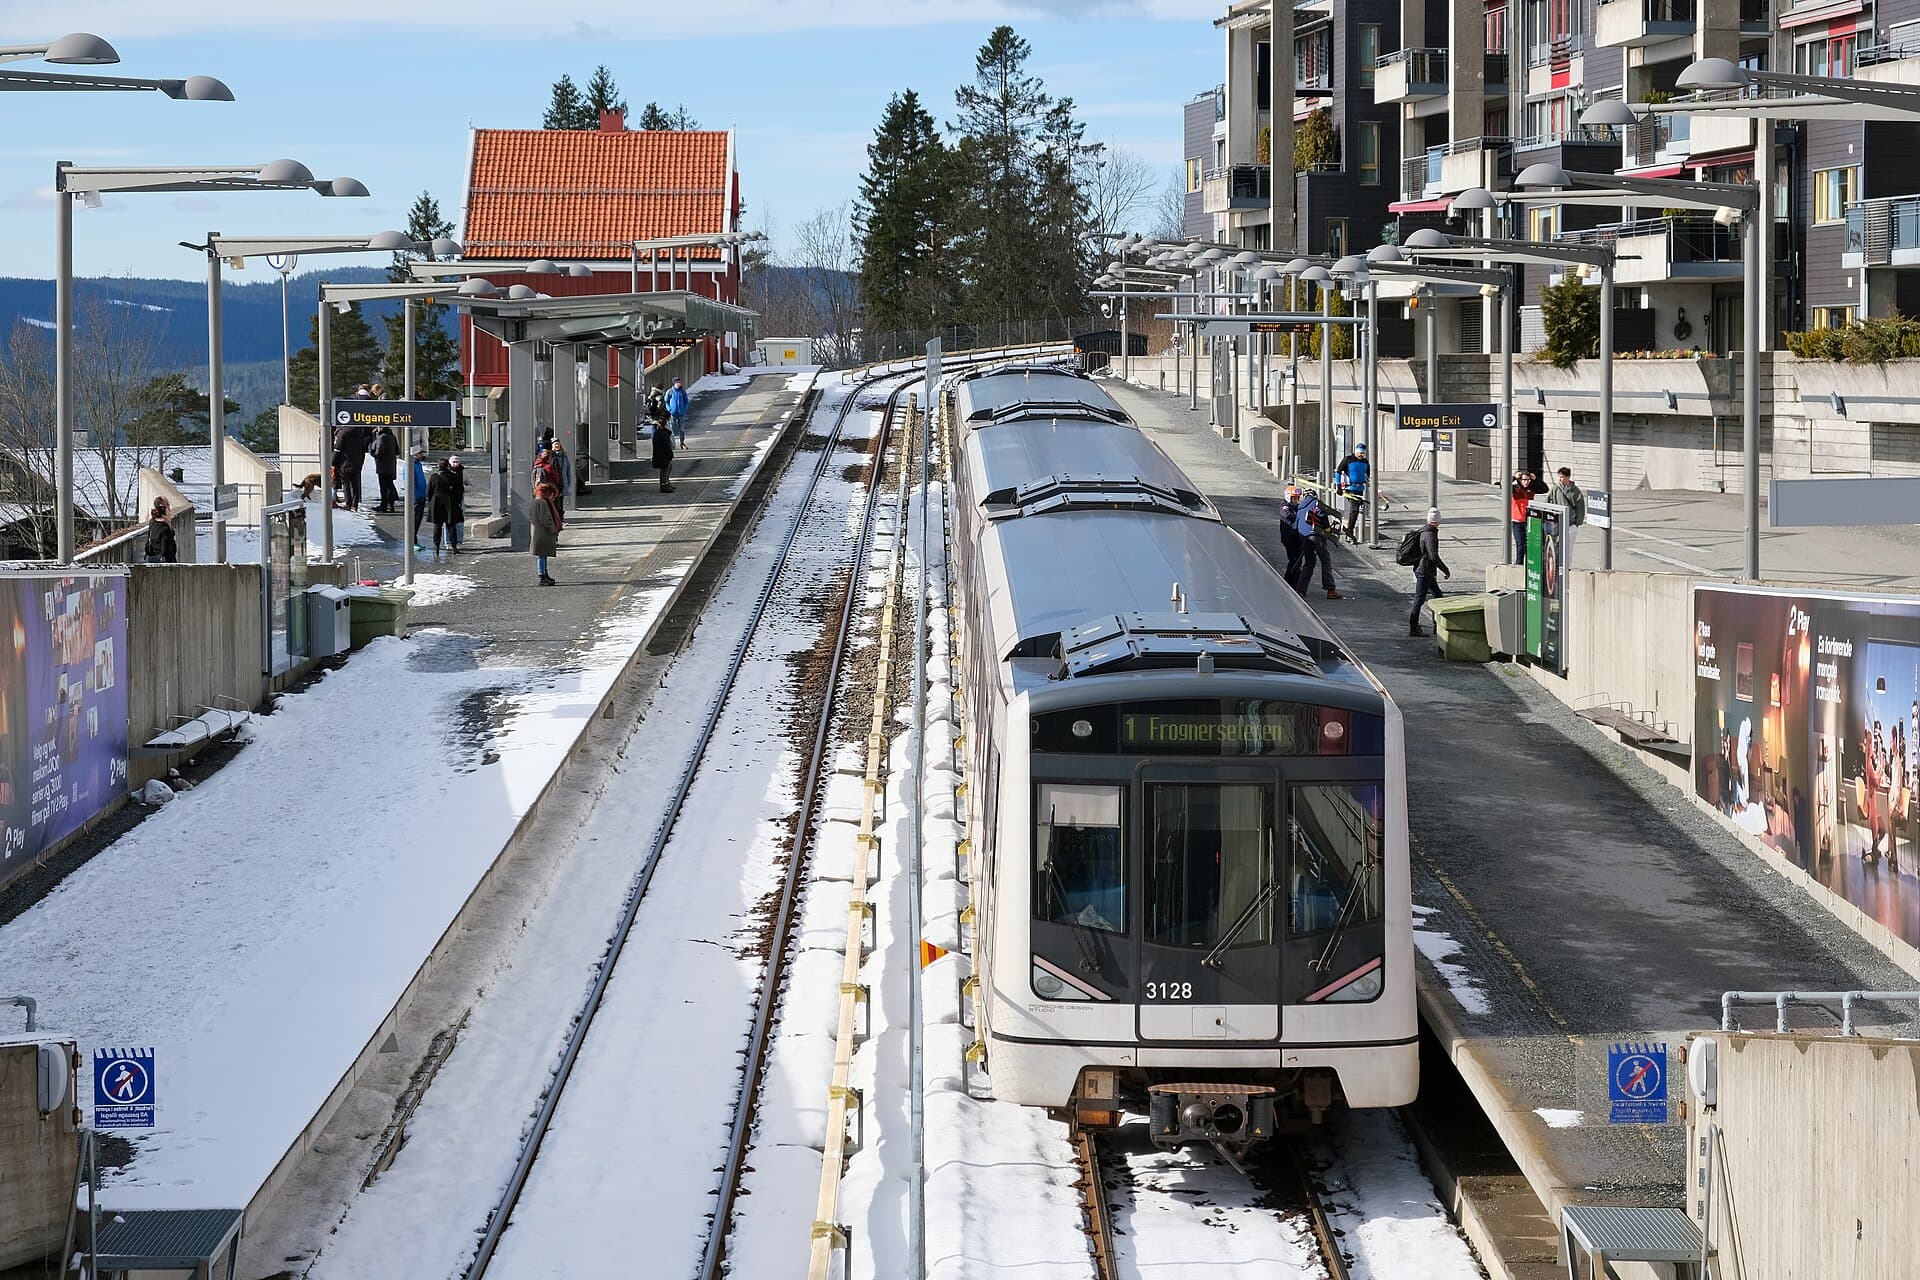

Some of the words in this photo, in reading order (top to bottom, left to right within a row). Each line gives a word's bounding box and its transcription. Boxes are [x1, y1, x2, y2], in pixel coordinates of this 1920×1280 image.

[353, 412, 391, 425] Utgang
[393, 413, 413, 423] Exit
[1402, 415, 1440, 427] Utgang
[1442, 415, 1461, 425] Exit
[1789, 604, 1797, 636] 2
[1126, 715, 1136, 741] 1
[110, 757, 116, 787] 2
[115, 758, 127, 779] Play
[4, 826, 12, 859] 2
[12, 827, 26, 850] Play
[1146, 982, 1193, 999] 3128
